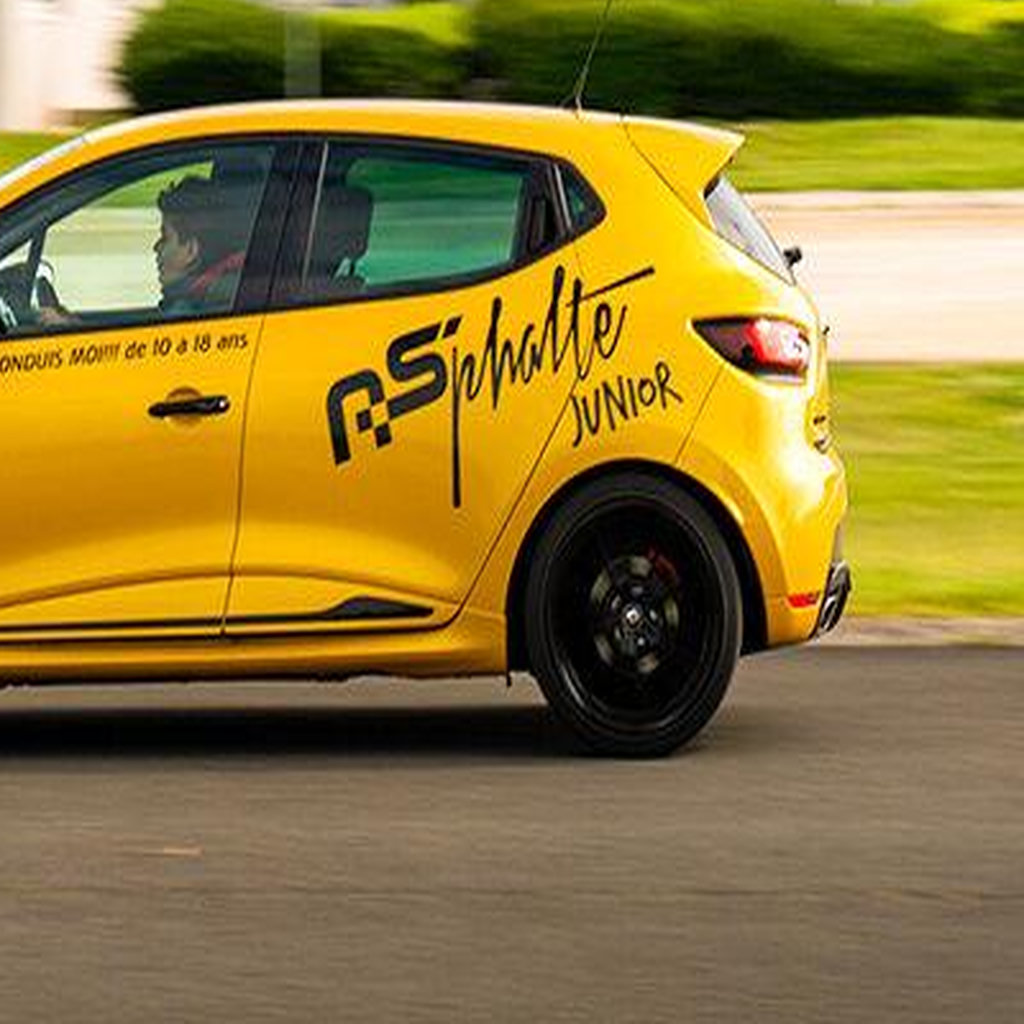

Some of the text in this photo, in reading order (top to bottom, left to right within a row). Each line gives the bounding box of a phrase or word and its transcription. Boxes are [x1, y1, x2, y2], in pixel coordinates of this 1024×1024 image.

[124, 339, 147, 360] de
[153, 336, 173, 357] 10
[193, 332, 212, 353] 18
[217, 333, 248, 351] ans
[571, 361, 683, 447] JUNIOR
